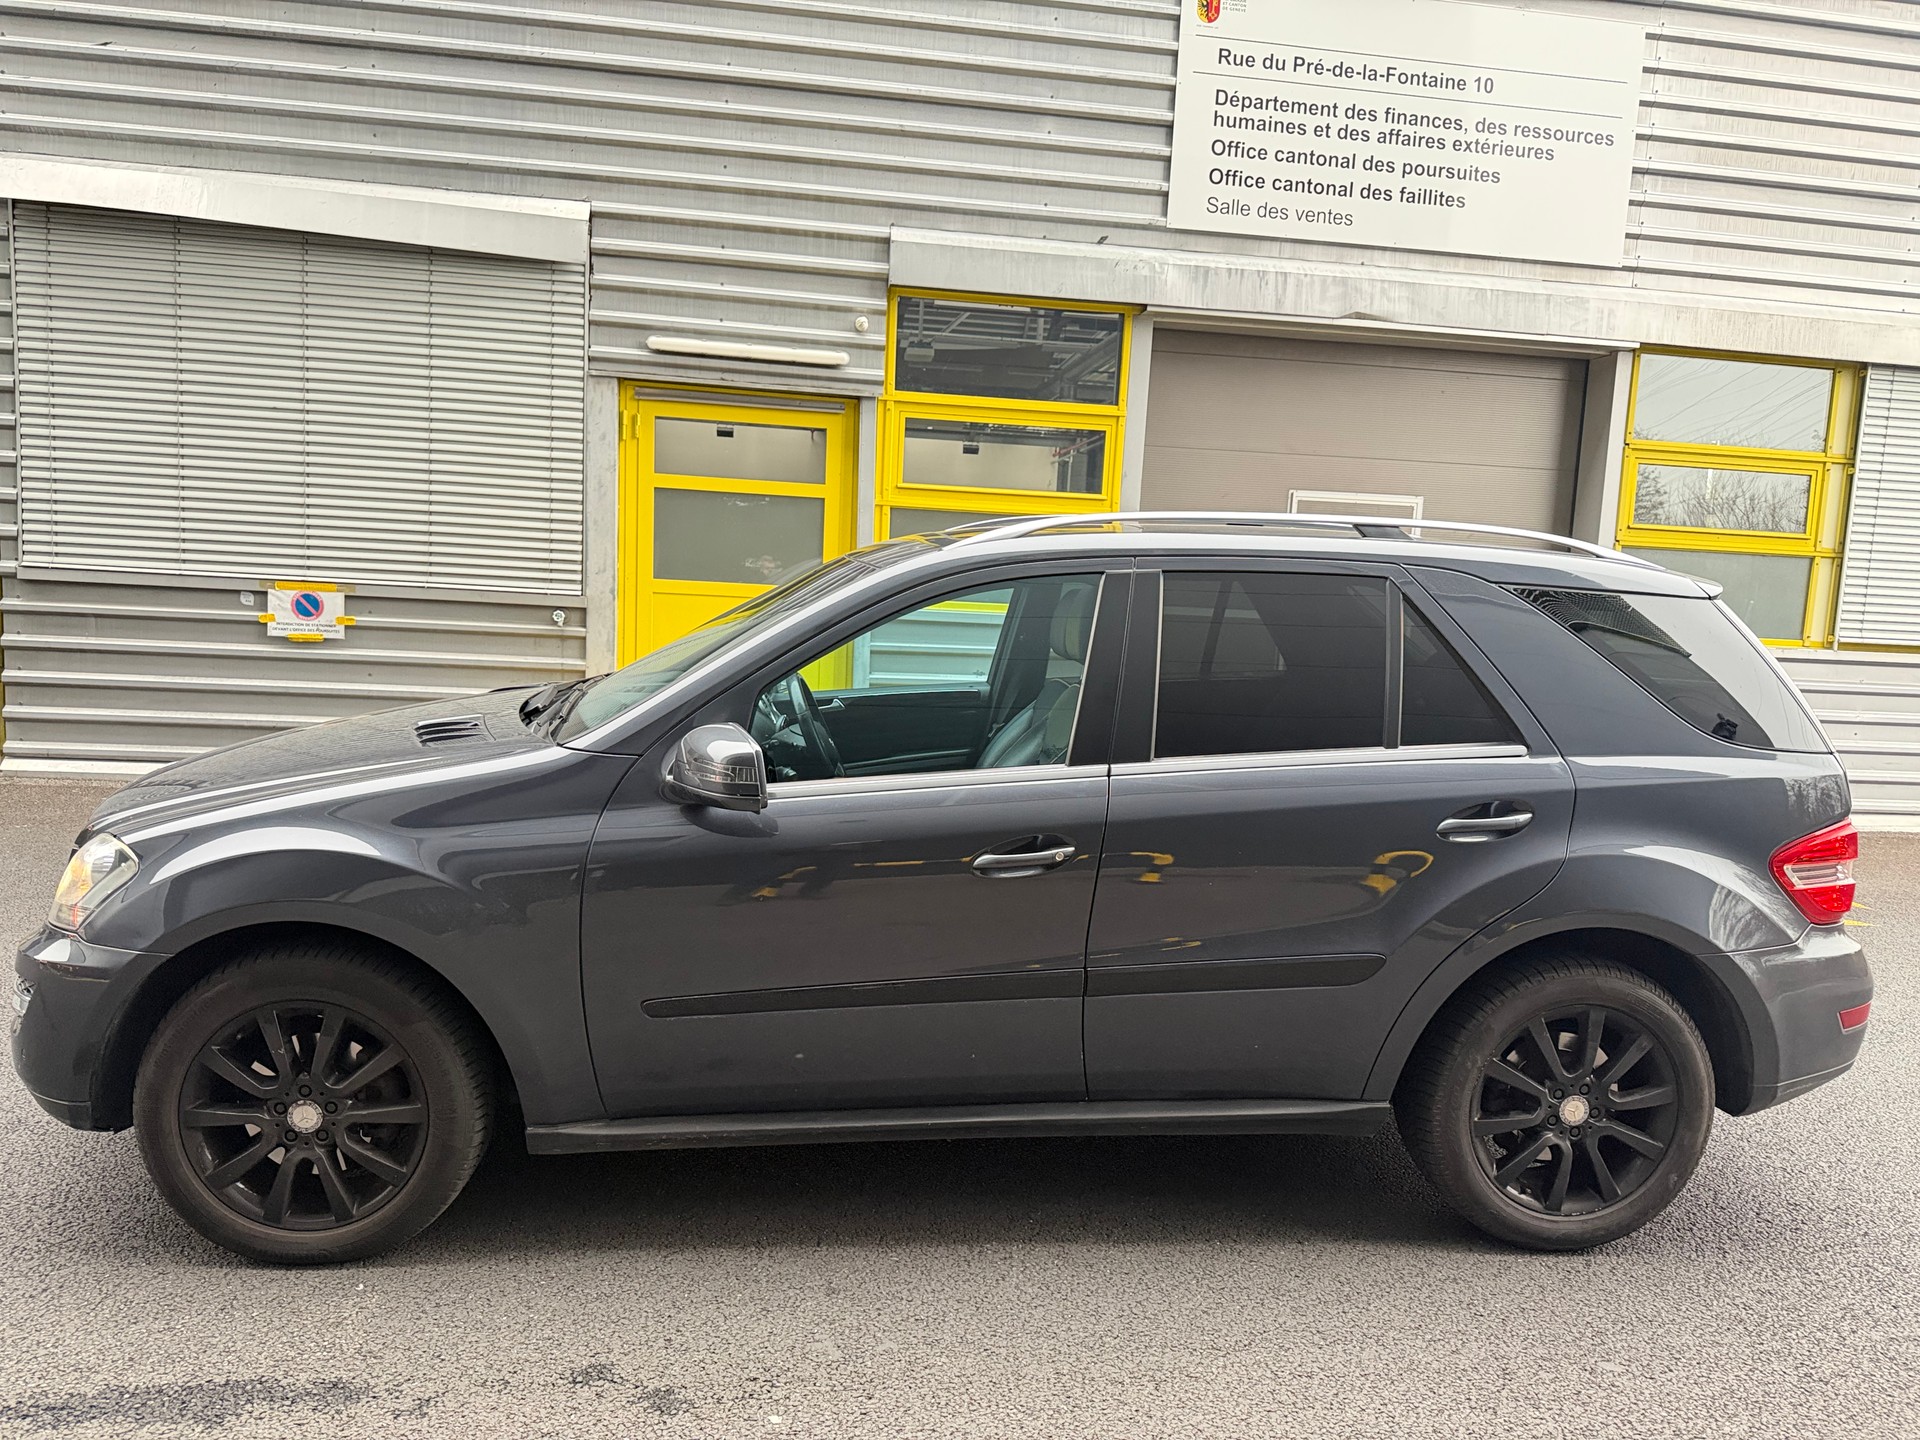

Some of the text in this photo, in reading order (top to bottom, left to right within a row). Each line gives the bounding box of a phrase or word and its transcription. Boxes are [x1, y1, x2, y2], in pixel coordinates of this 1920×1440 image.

[1219, 48, 1493, 93] Rue du Pré-de-la-Fontaine 10
[1214, 110, 1554, 160] humaines et des affaires extérieures
[1215, 89, 1613, 146] Département des finances, des ressources
[1212, 139, 1500, 183] Office cantonal des poursuites
[1209, 168, 1465, 208] Office cantonal des faillites
[1207, 197, 1352, 226] Salle des ventes
